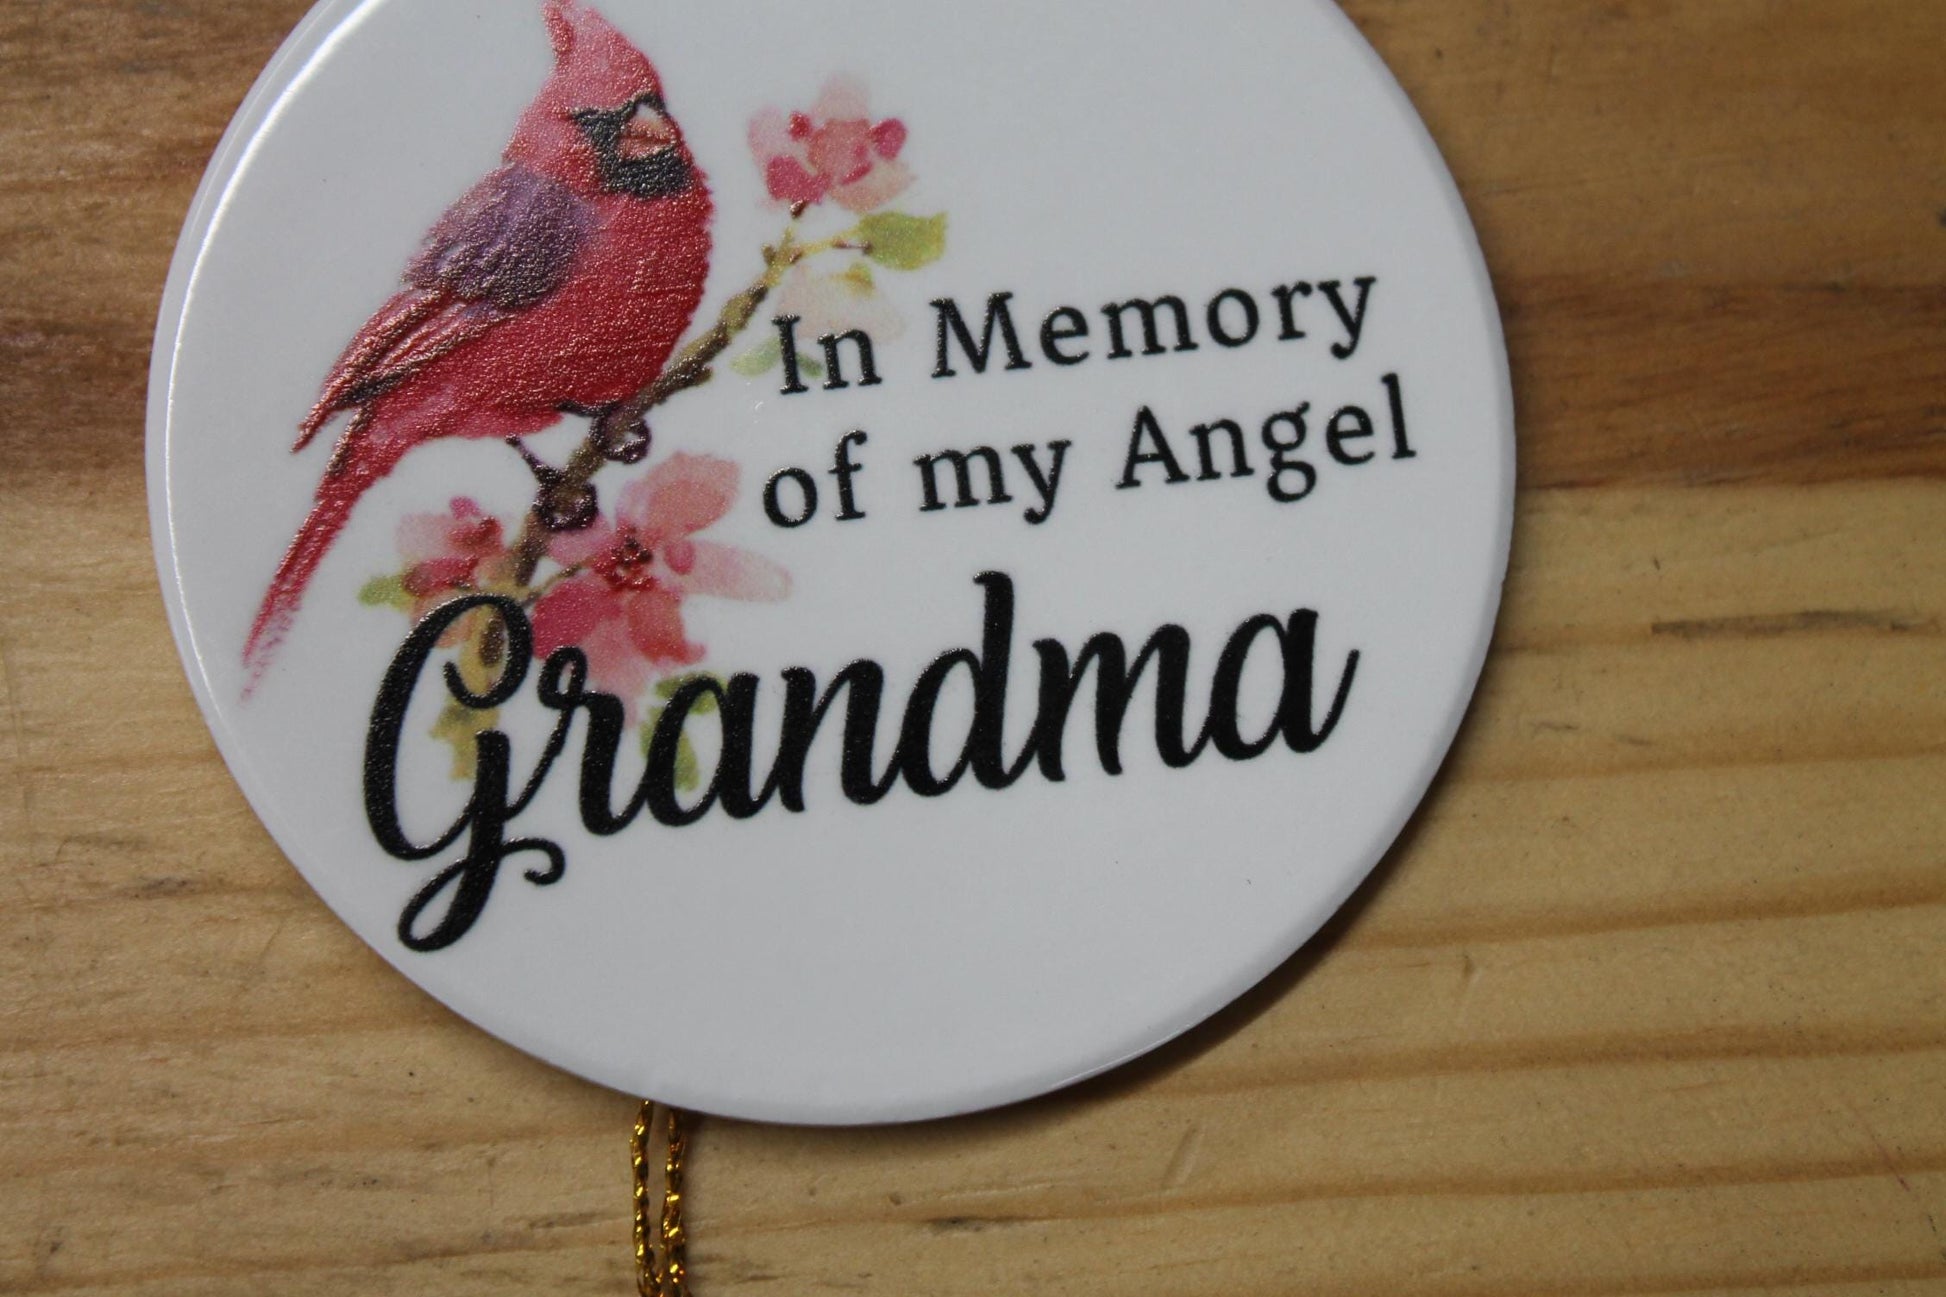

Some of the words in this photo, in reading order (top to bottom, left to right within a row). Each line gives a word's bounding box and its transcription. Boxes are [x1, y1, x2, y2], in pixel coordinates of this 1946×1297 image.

[771, 314, 882, 395] In
[929, 275, 1377, 378] Memory
[762, 429, 869, 529] of
[912, 439, 1073, 525] my
[1115, 372, 1417, 503] Angel
[362, 569, 1361, 954] Grandma
